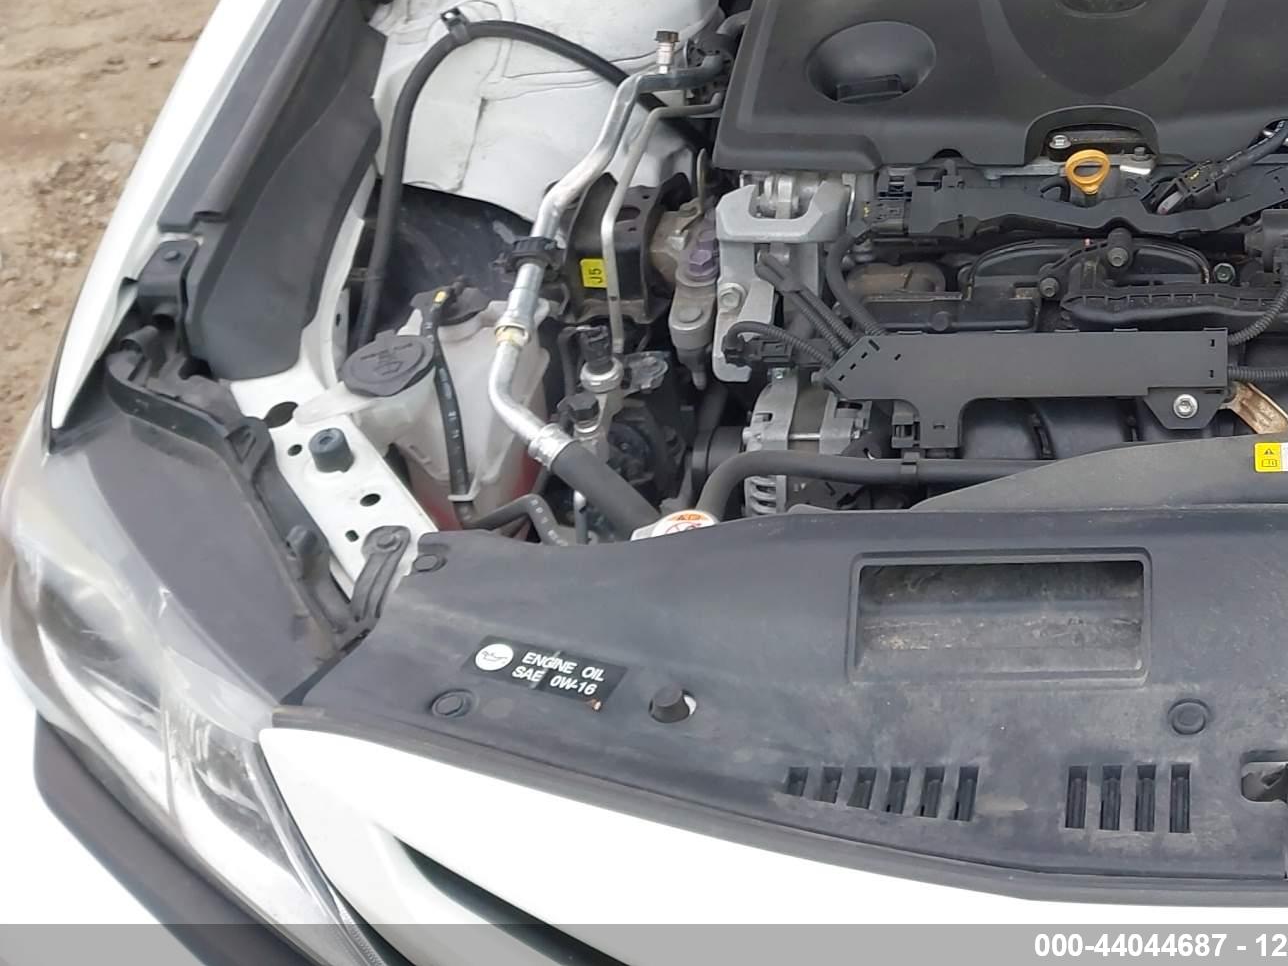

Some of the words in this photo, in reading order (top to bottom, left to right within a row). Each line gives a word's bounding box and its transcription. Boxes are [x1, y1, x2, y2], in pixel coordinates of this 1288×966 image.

[588, 267, 603, 284] J5
[511, 665, 545, 682] SAE
[549, 675, 598, 696] 0W-16
[522, 651, 577, 674] ENGINE
[581, 666, 605, 682] OIL
